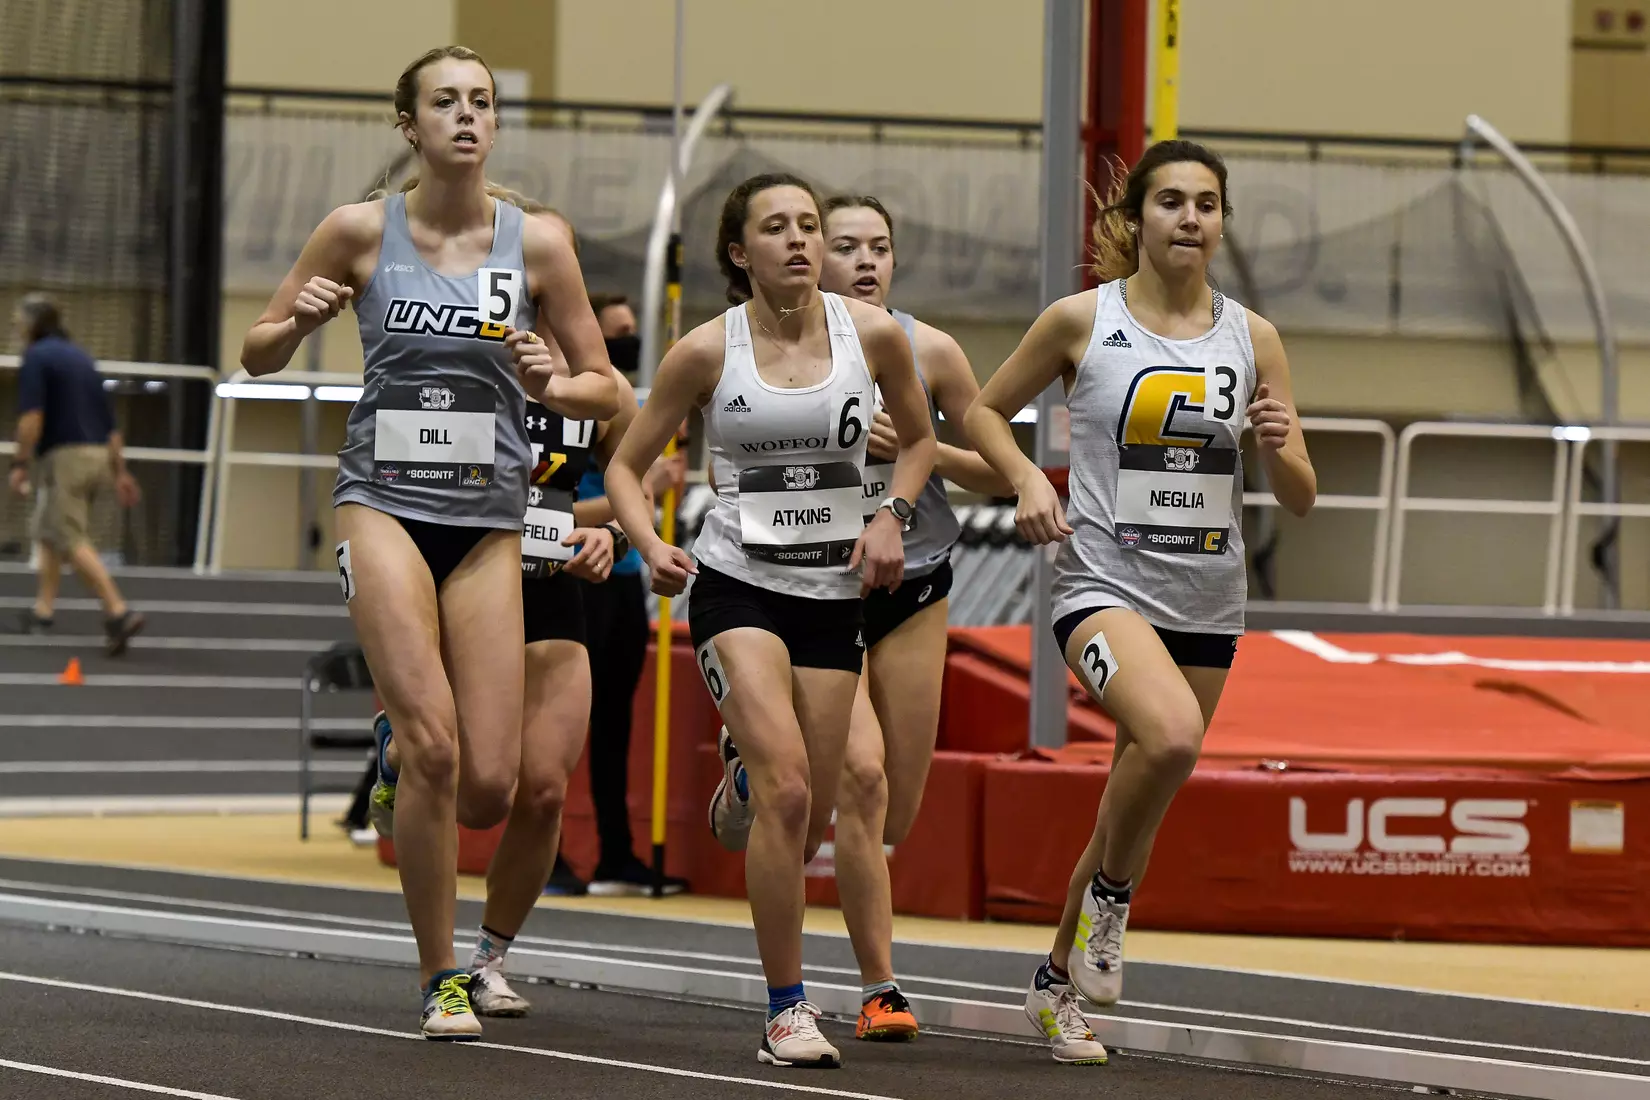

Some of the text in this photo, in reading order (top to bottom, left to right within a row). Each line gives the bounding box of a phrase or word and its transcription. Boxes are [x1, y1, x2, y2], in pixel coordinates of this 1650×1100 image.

[489, 271, 512, 321] 5
[1102, 339, 1132, 349] adidas
[1213, 366, 1237, 420] 3
[723, 405, 752, 413] adidas
[837, 396, 862, 449] 6
[419, 428, 453, 446] DILL
[406, 469, 454, 480] #SOCONTF
[861, 481, 886, 499] UP
[1150, 489, 1205, 510] NEGLIA
[772, 506, 831, 527] ATKINS
[1147, 533, 1195, 546] #SOCONTF
[1204, 531, 1222, 551] C
[773, 550, 823, 560] #SOCONTF
[336, 546, 350, 601] 5
[701, 648, 724, 701] 6
[1084, 642, 1109, 691] 3
[1289, 797, 1530, 853] UCS
